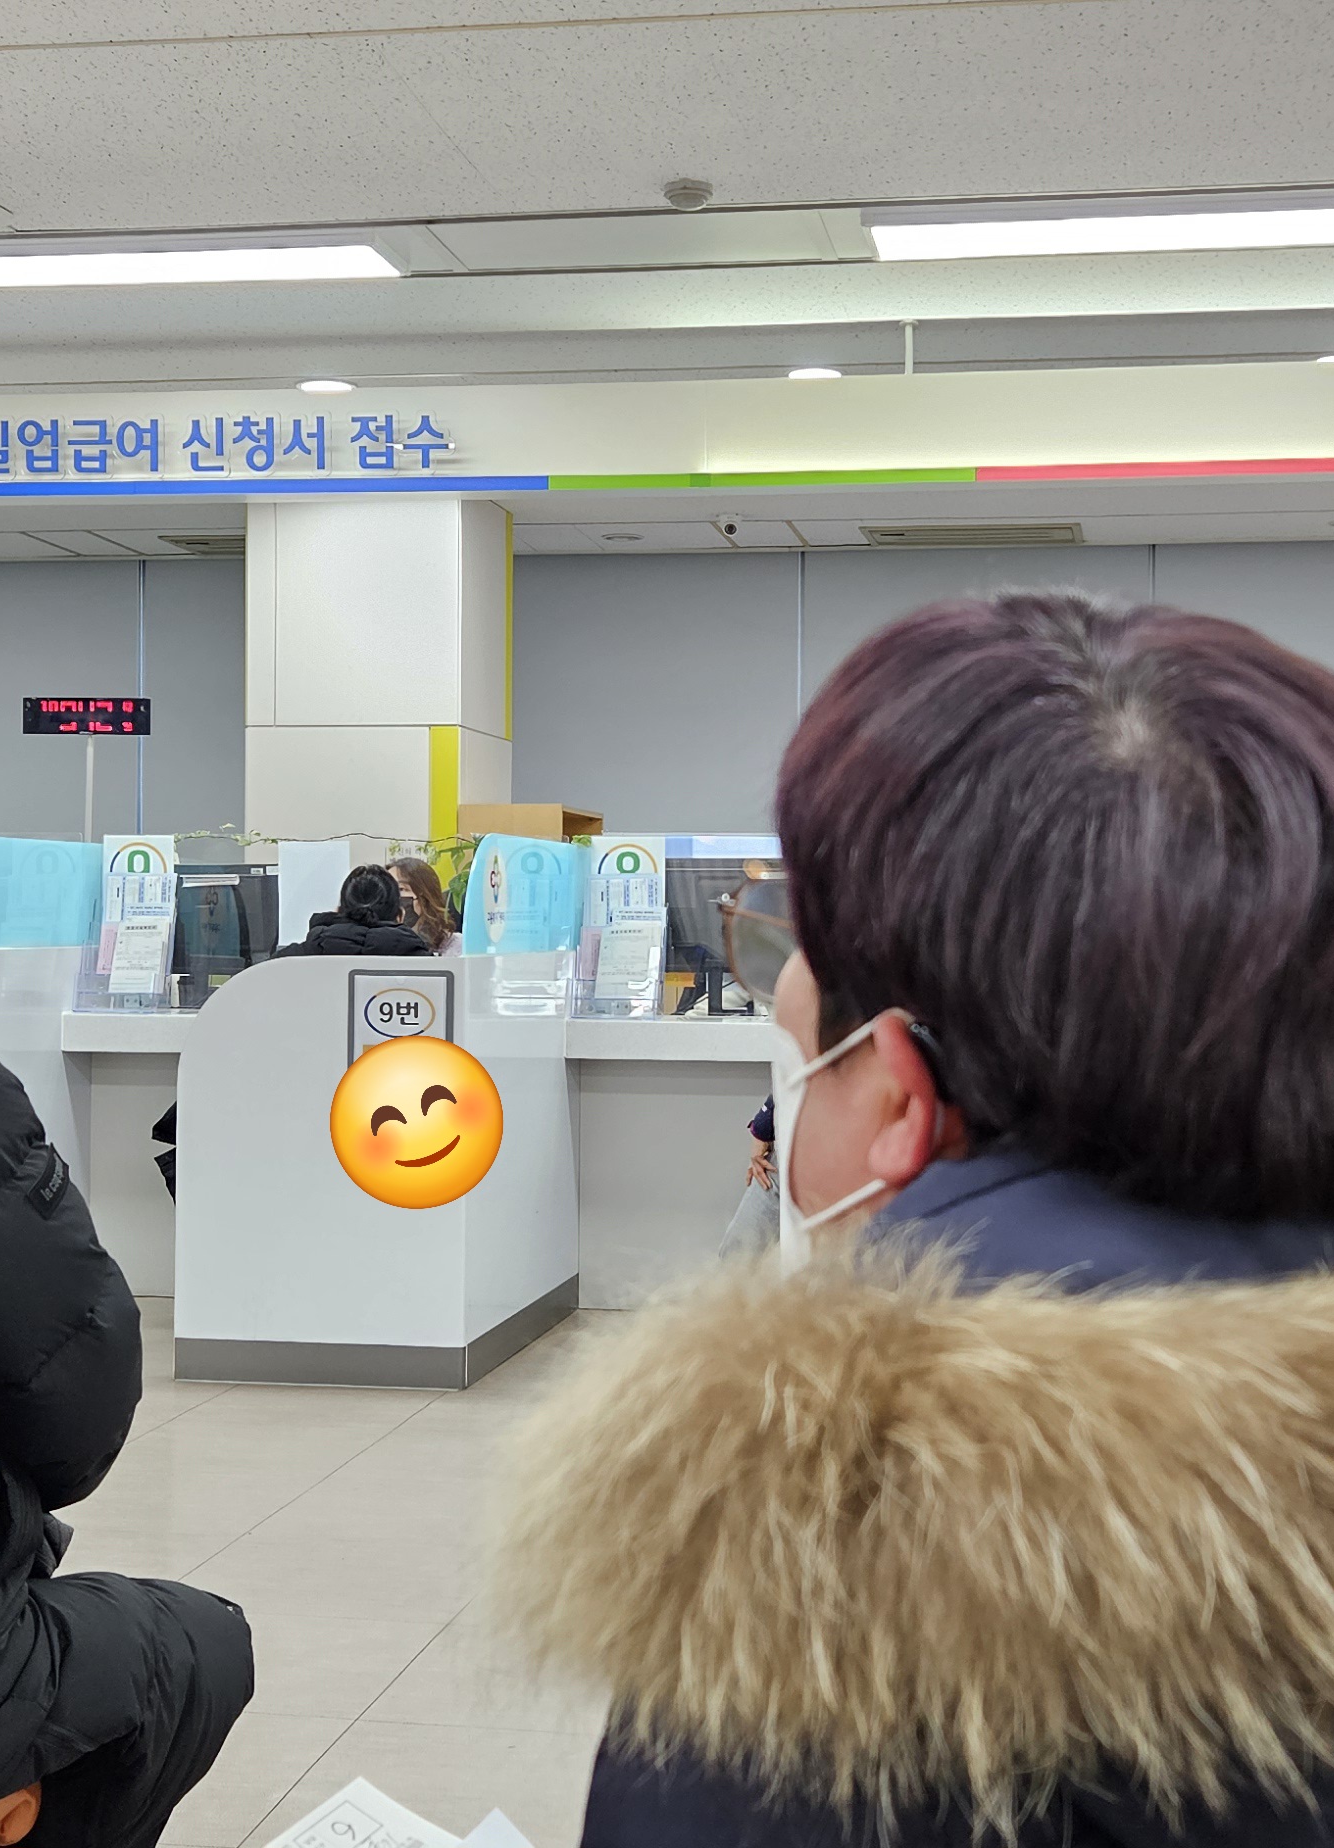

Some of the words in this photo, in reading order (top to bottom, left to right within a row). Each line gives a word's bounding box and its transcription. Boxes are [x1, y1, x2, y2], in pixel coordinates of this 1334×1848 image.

[182, 415, 327, 474] 신청서
[350, 413, 450, 470] 접수
[379, 1001, 420, 1026] 9번
